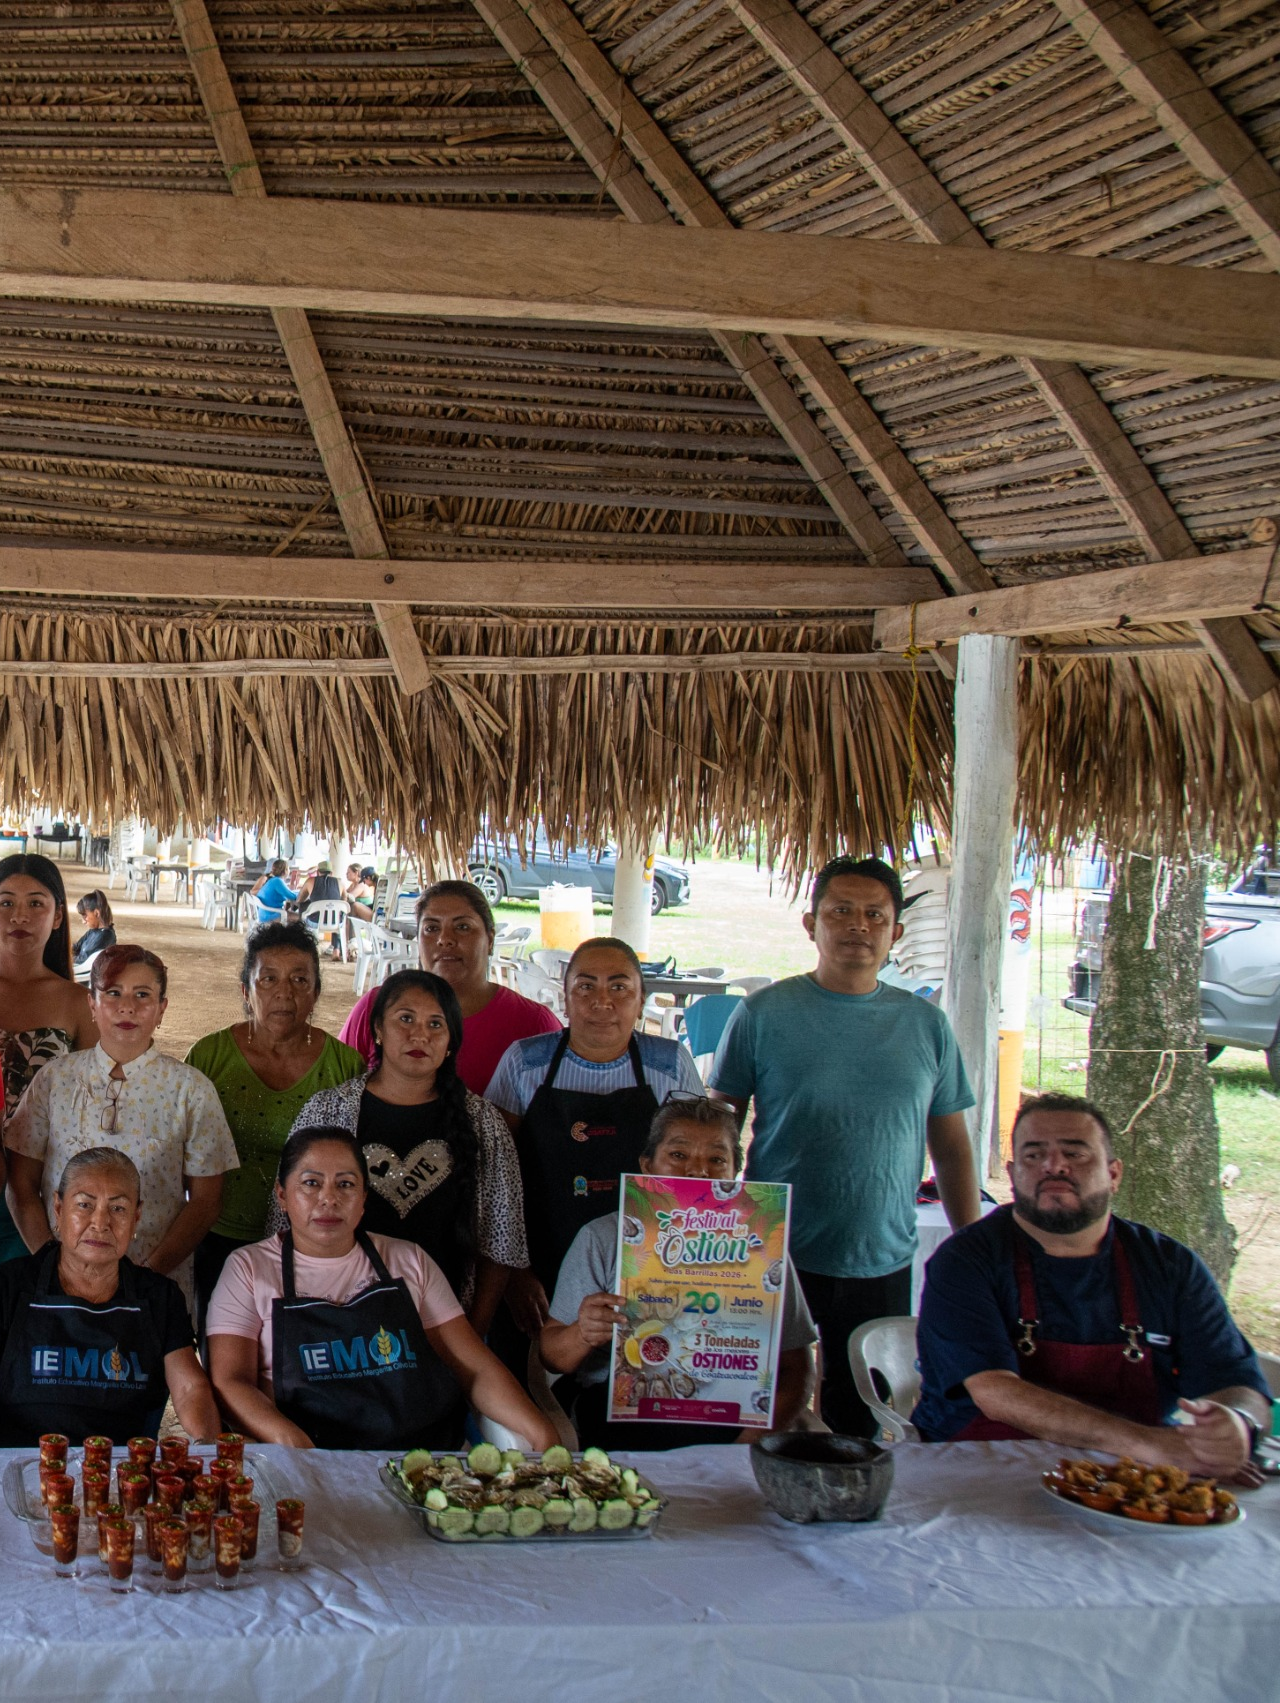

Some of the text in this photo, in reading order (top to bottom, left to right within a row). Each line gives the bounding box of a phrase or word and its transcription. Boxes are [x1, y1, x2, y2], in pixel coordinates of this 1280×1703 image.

[396, 1157, 438, 1200] LOVE
[661, 1231, 748, 1266] Ostión
[685, 1268, 718, 1277] Barrillas
[637, 1291, 763, 1315] Sábado 20 Junio
[694, 1333, 760, 1349] 3 Toneladas
[692, 1352, 759, 1371] OSTIONES
